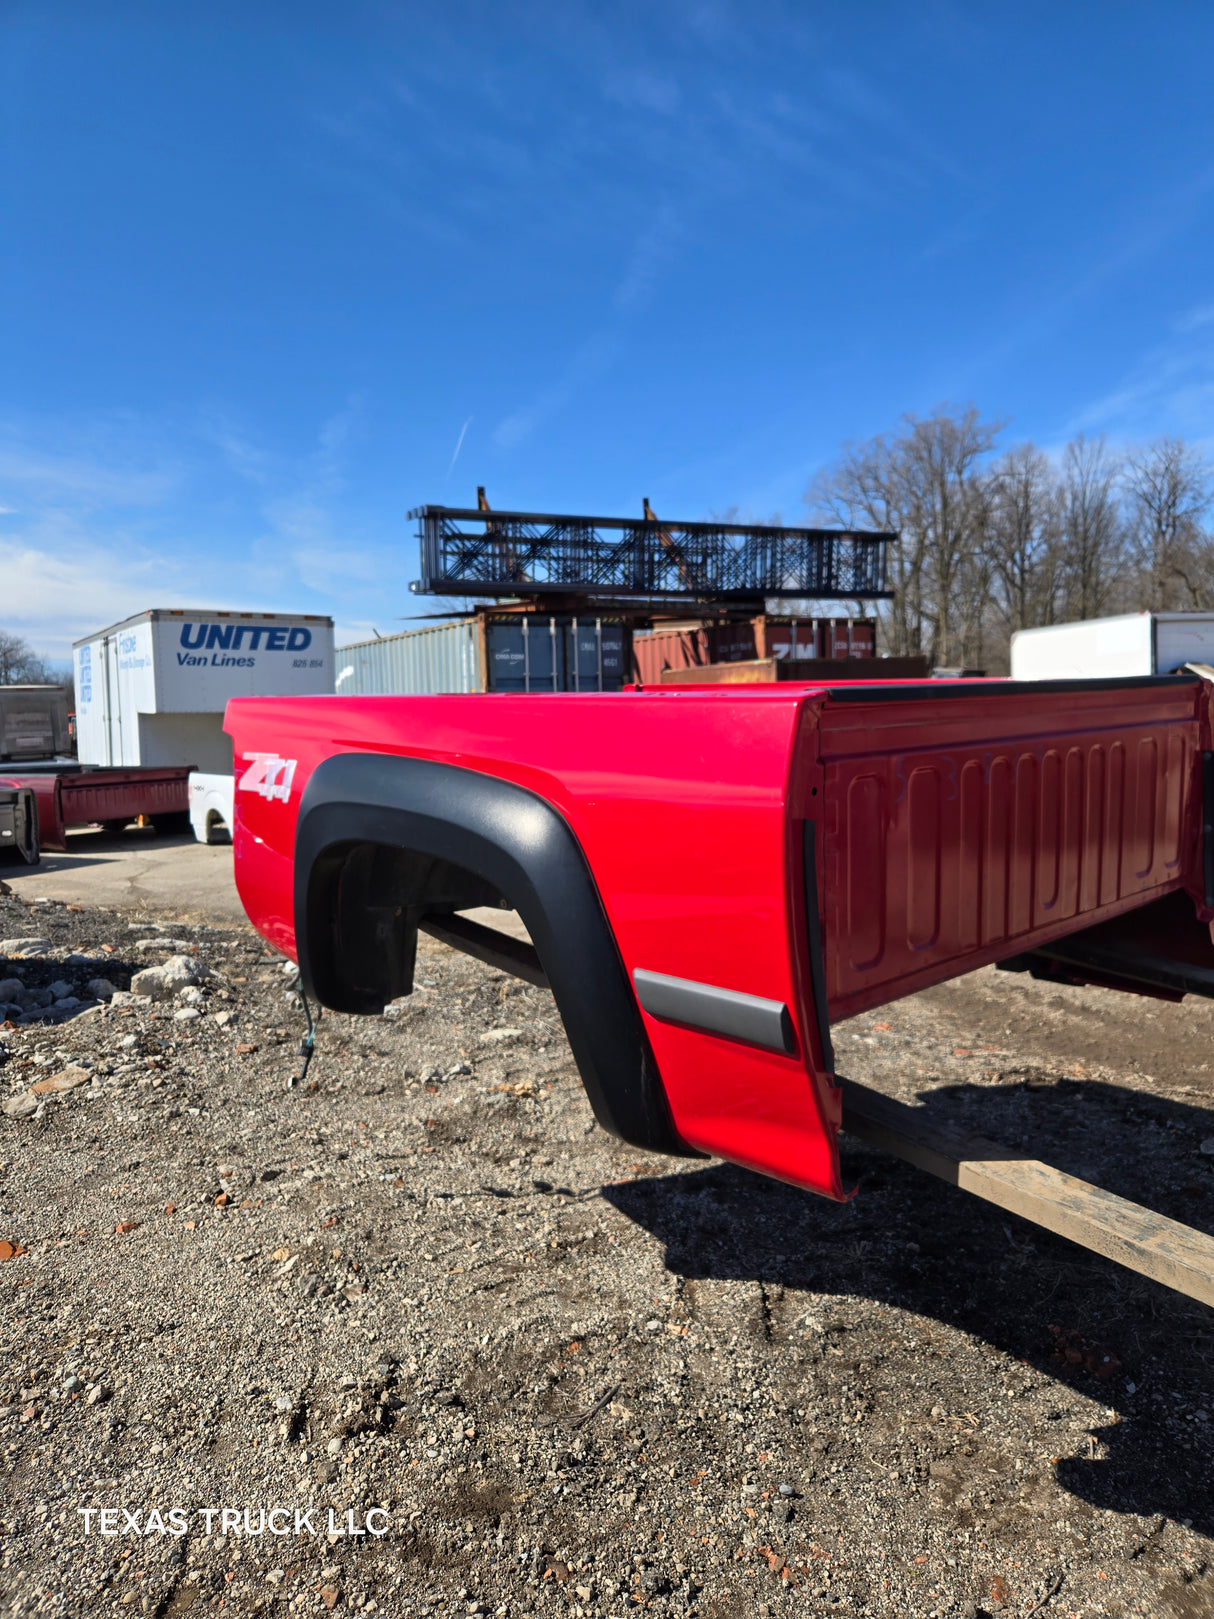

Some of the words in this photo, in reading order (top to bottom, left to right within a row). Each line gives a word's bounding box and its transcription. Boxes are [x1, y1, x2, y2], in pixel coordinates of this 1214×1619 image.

[180, 623, 312, 651] UNITED
[176, 652, 207, 667] Van
[211, 653, 256, 667] Lines
